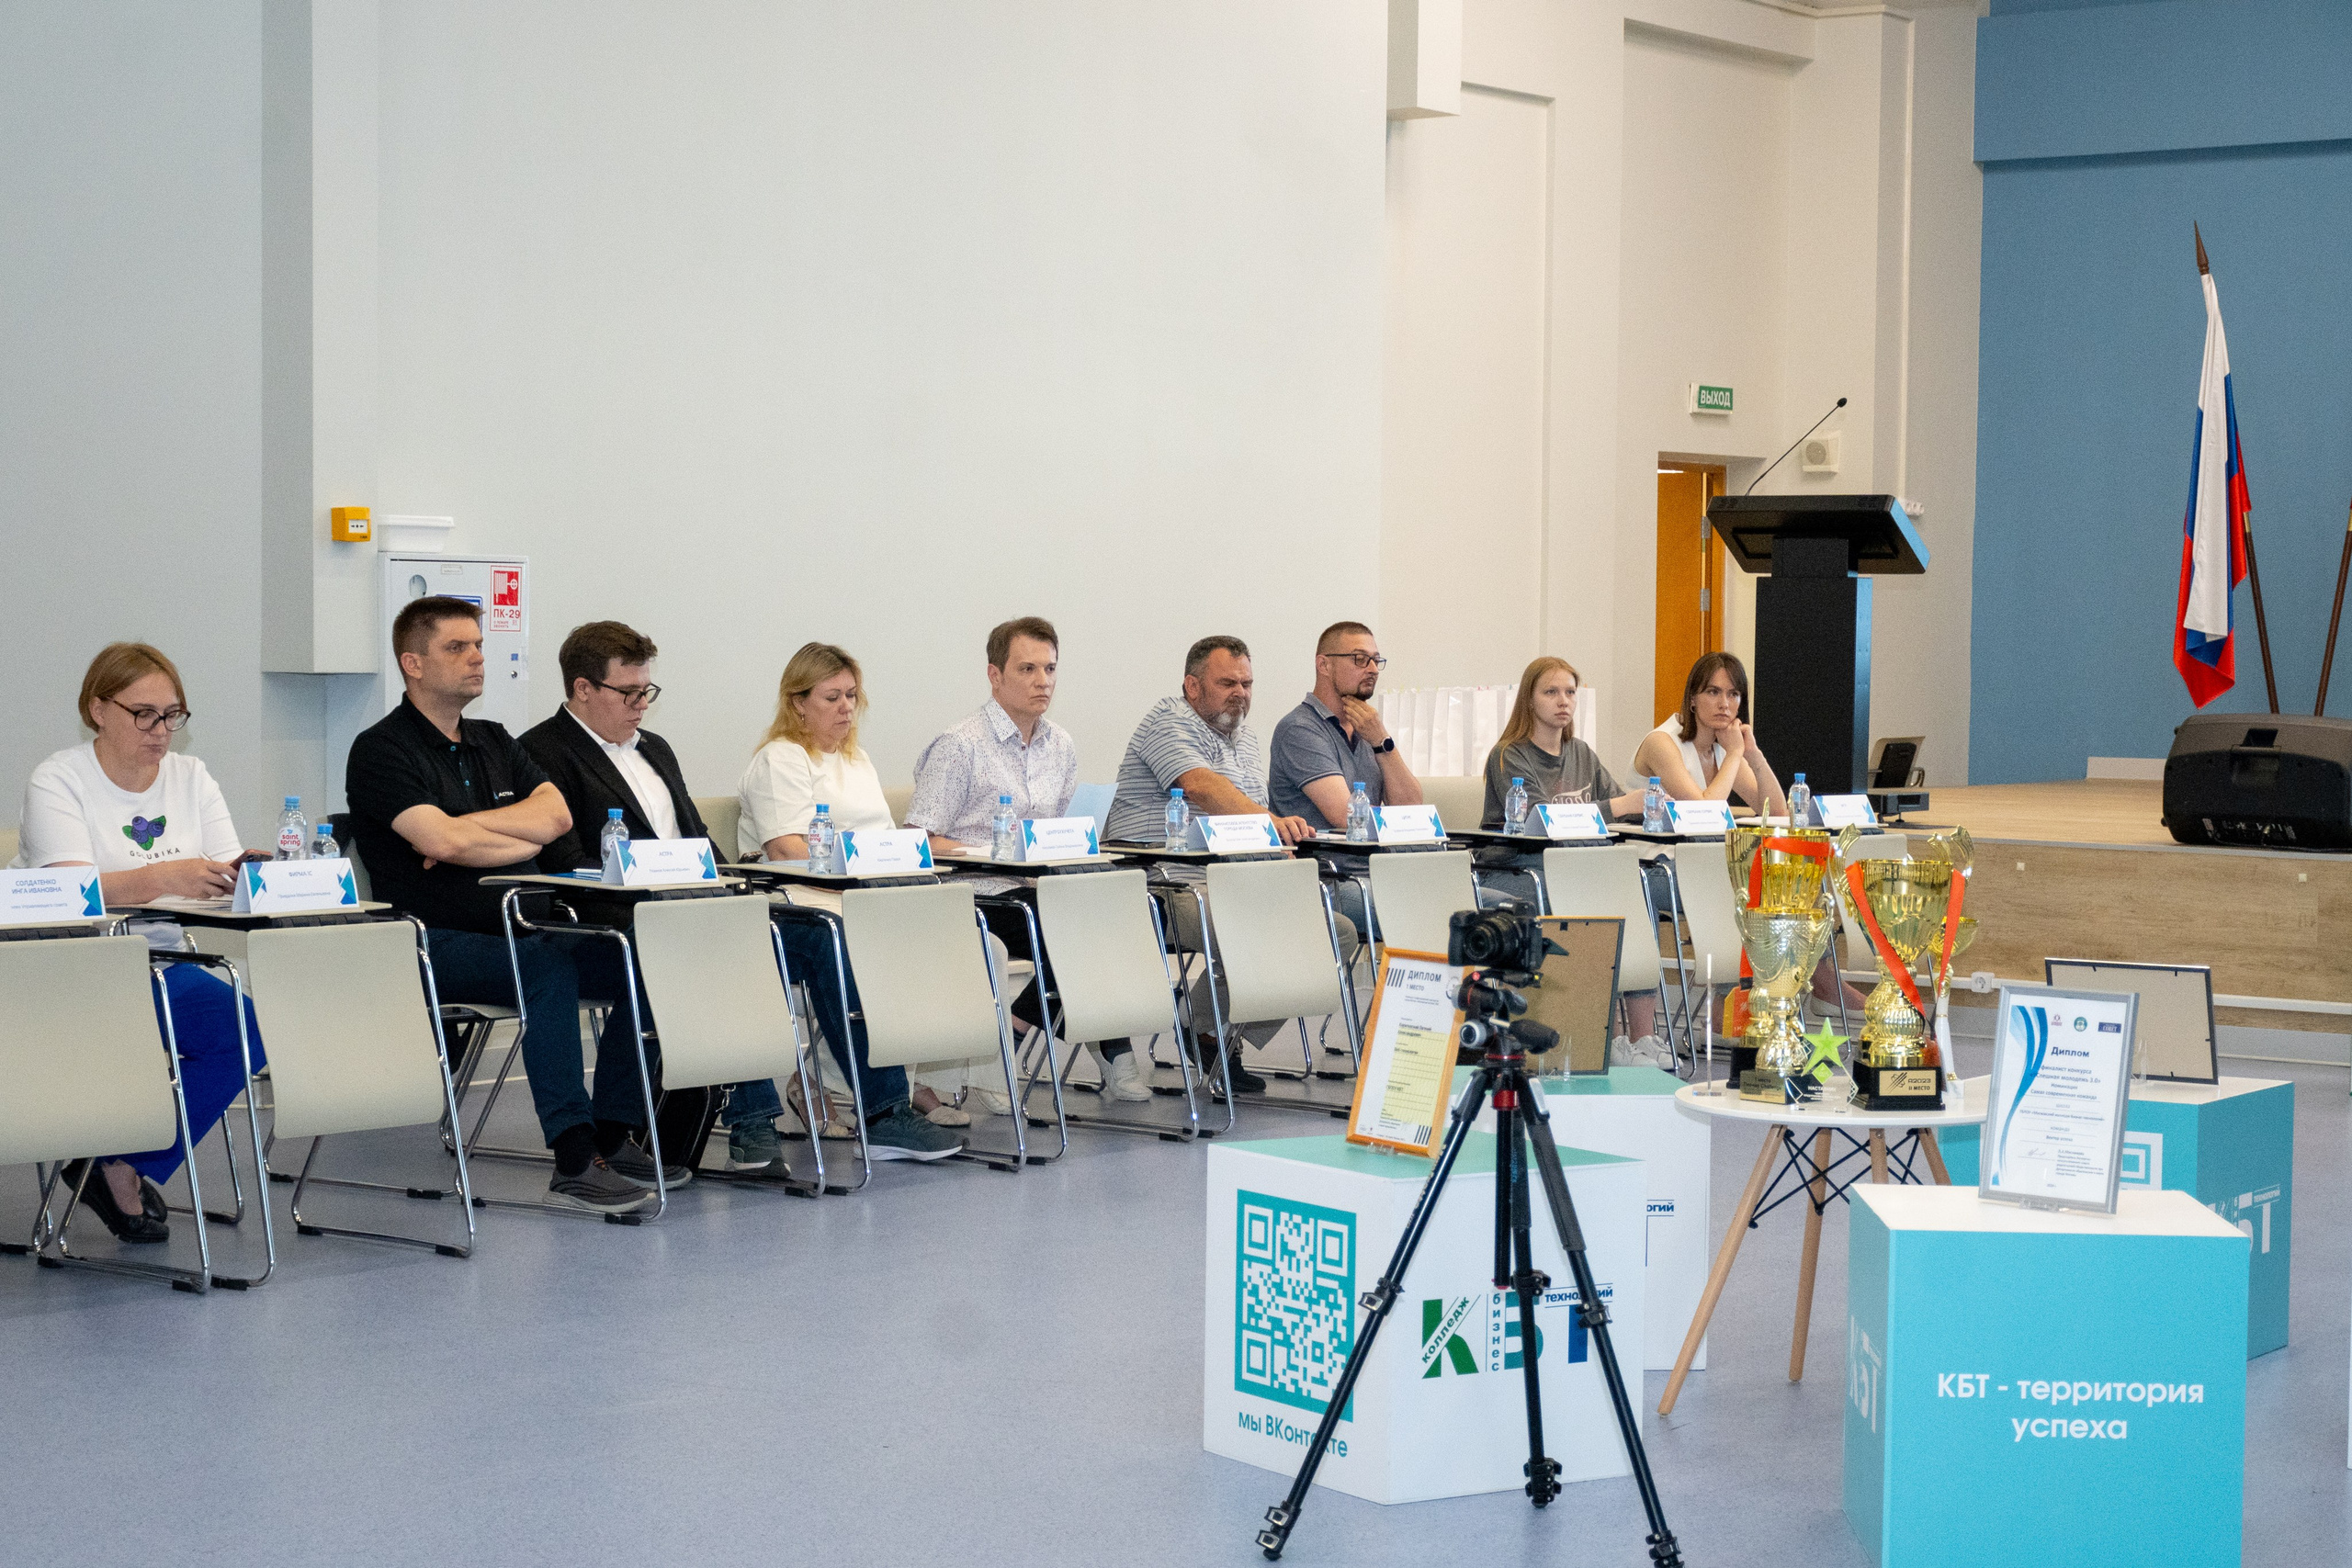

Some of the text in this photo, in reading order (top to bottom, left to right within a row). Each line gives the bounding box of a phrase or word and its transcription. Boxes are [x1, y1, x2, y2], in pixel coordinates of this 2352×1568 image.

[1700, 389, 1731, 408] ВЫХОД
[493, 608, 521, 619] ПК-29
[130, 847, 181, 860] GOLUBIKA
[1408, 970, 1442, 983] ДИПЛОМ
[1409, 984, 1425, 992] МЕСТО
[2051, 1046, 2090, 1057] Диплом
[2041, 1065, 2067, 1073] финалист
[1421, 1295, 1471, 1364] колледж
[1491, 1292, 1502, 1372] бизнес
[1937, 1372, 1990, 1399] КБТ
[2017, 1380, 2205, 1408] территория
[1265, 1414, 1349, 1458] ВКонтте
[2011, 1417, 2128, 1443] успеха
